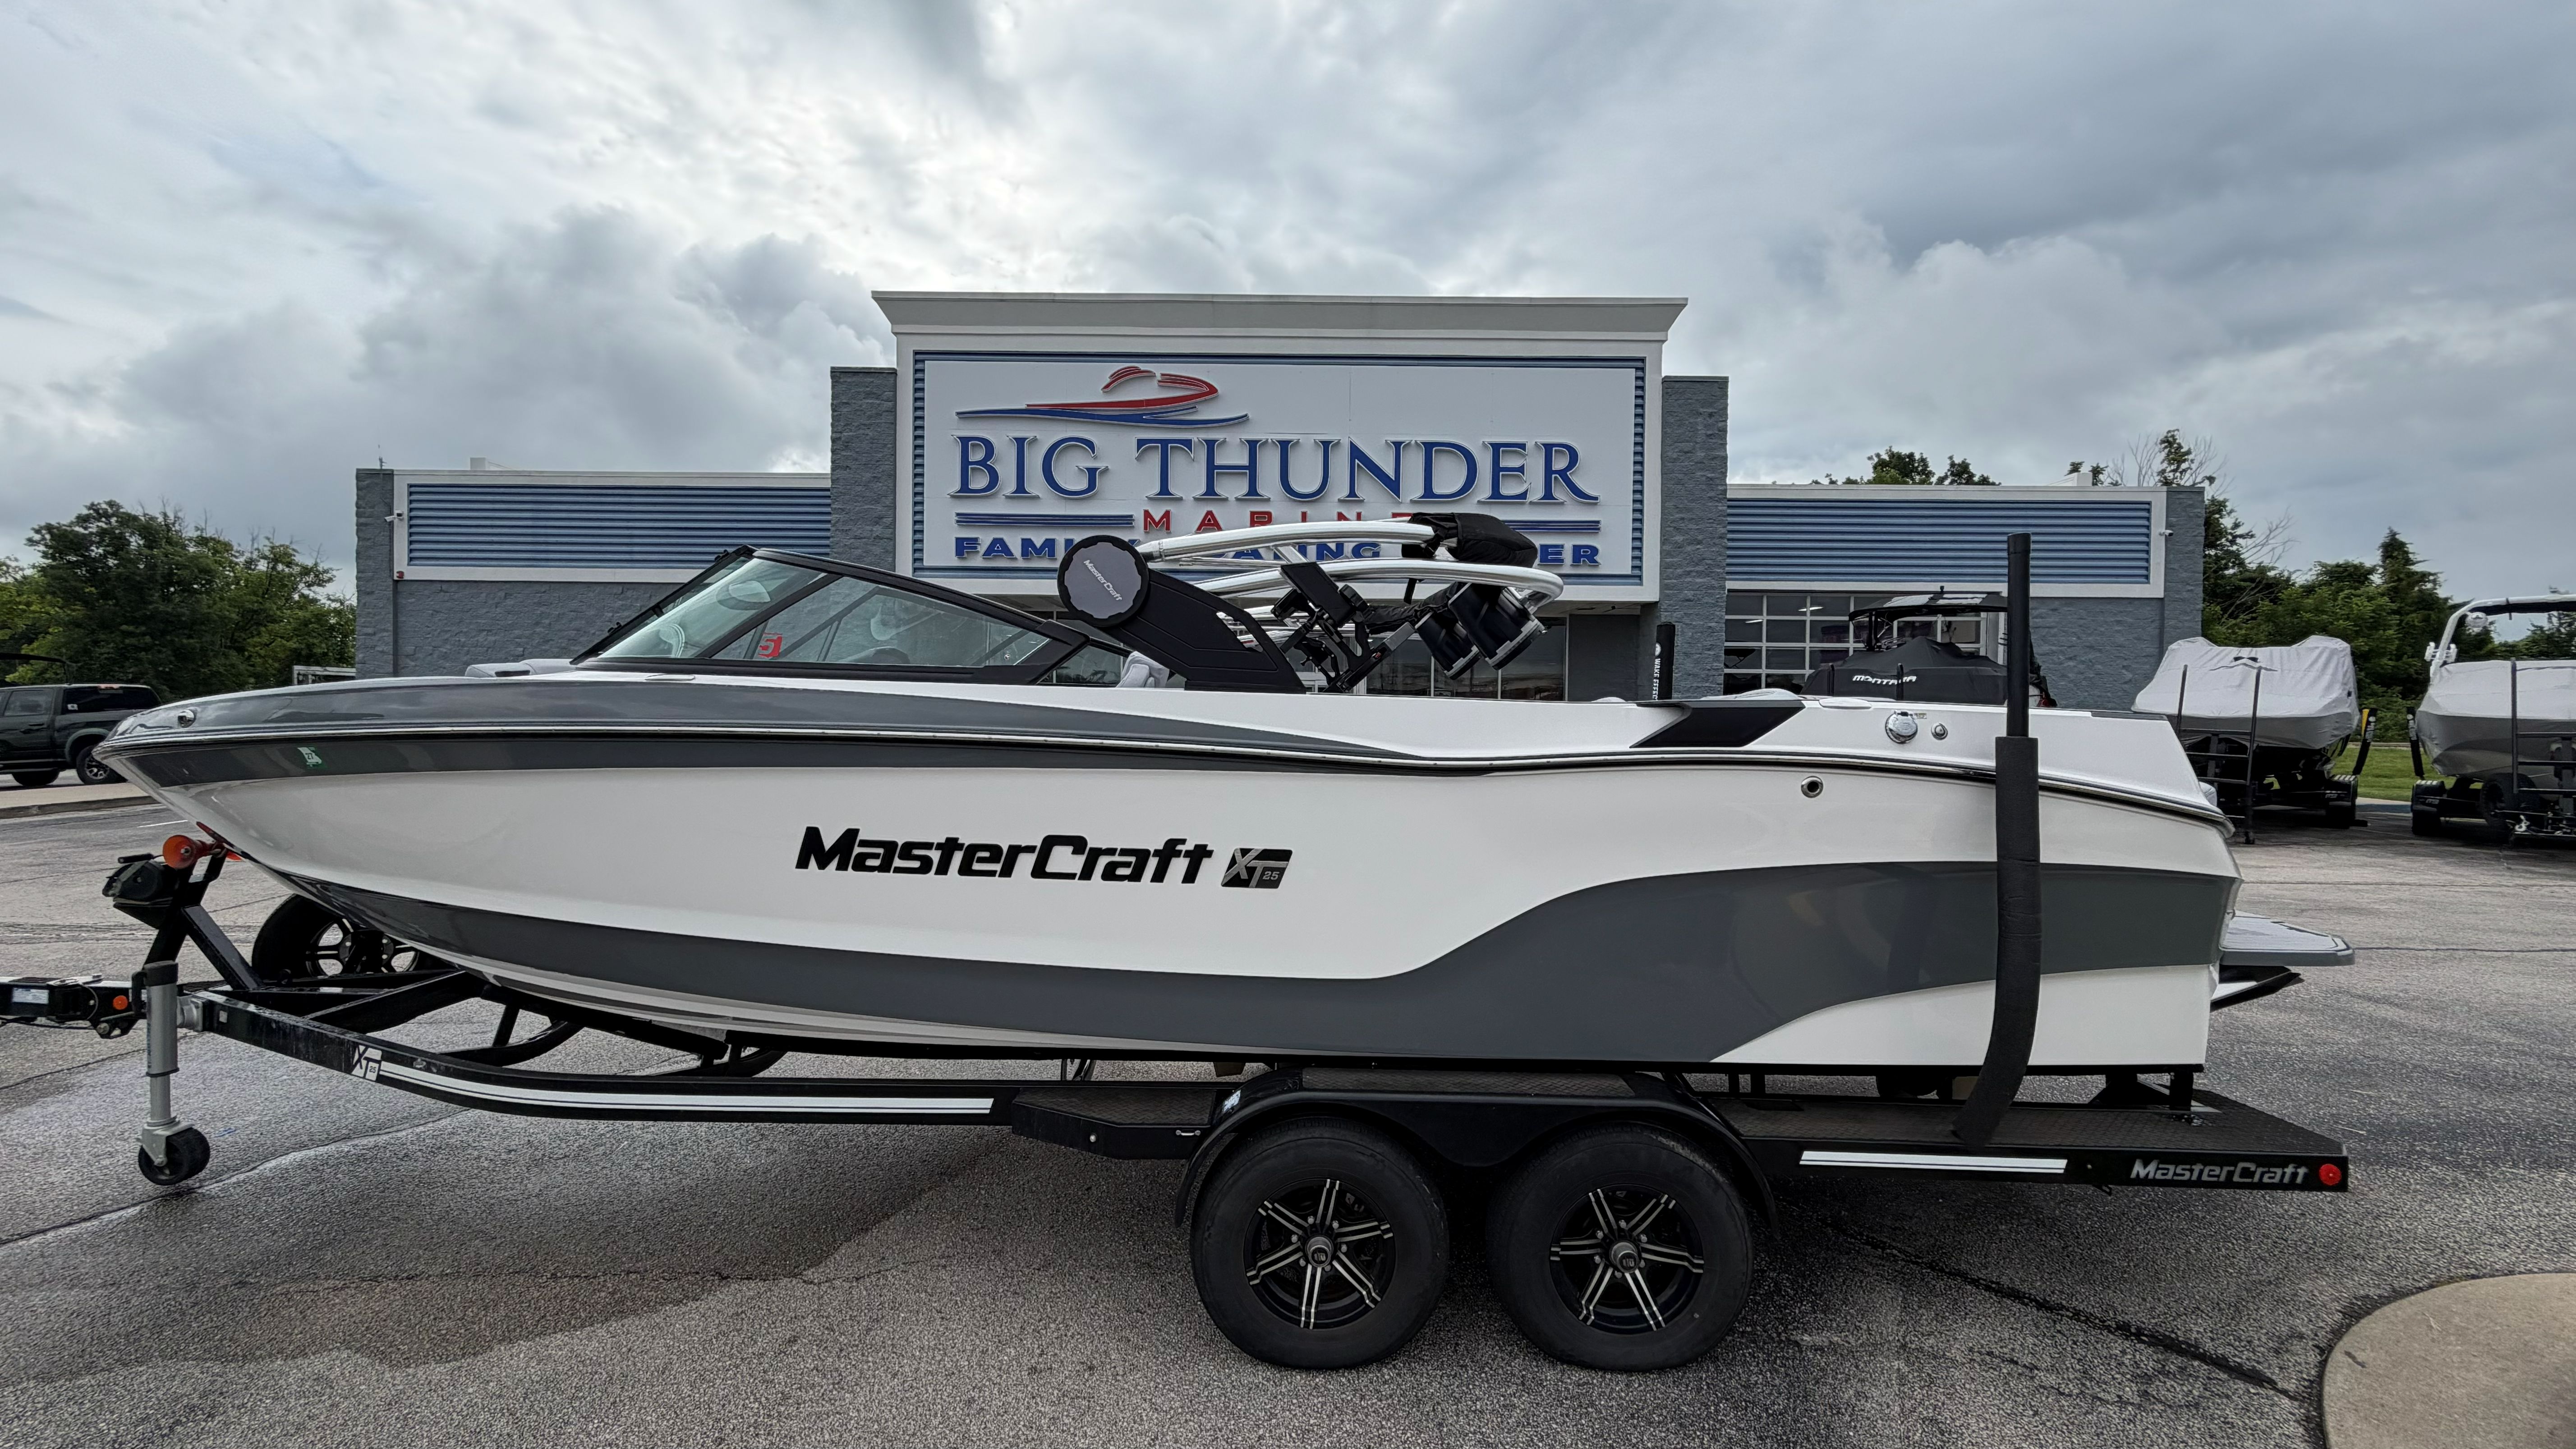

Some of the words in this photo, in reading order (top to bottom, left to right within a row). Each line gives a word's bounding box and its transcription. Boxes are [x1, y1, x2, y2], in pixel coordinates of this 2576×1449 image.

[947, 434, 1109, 498] BIG
[1135, 437, 1601, 503] THUNDER
[1083, 559, 1122, 601] MasterCraft
[795, 826, 1214, 884] MasterCraft
[1221, 847, 1289, 888] XT
[1262, 871, 1280, 880] 25
[2130, 1158, 2309, 1184] MasterCraft
